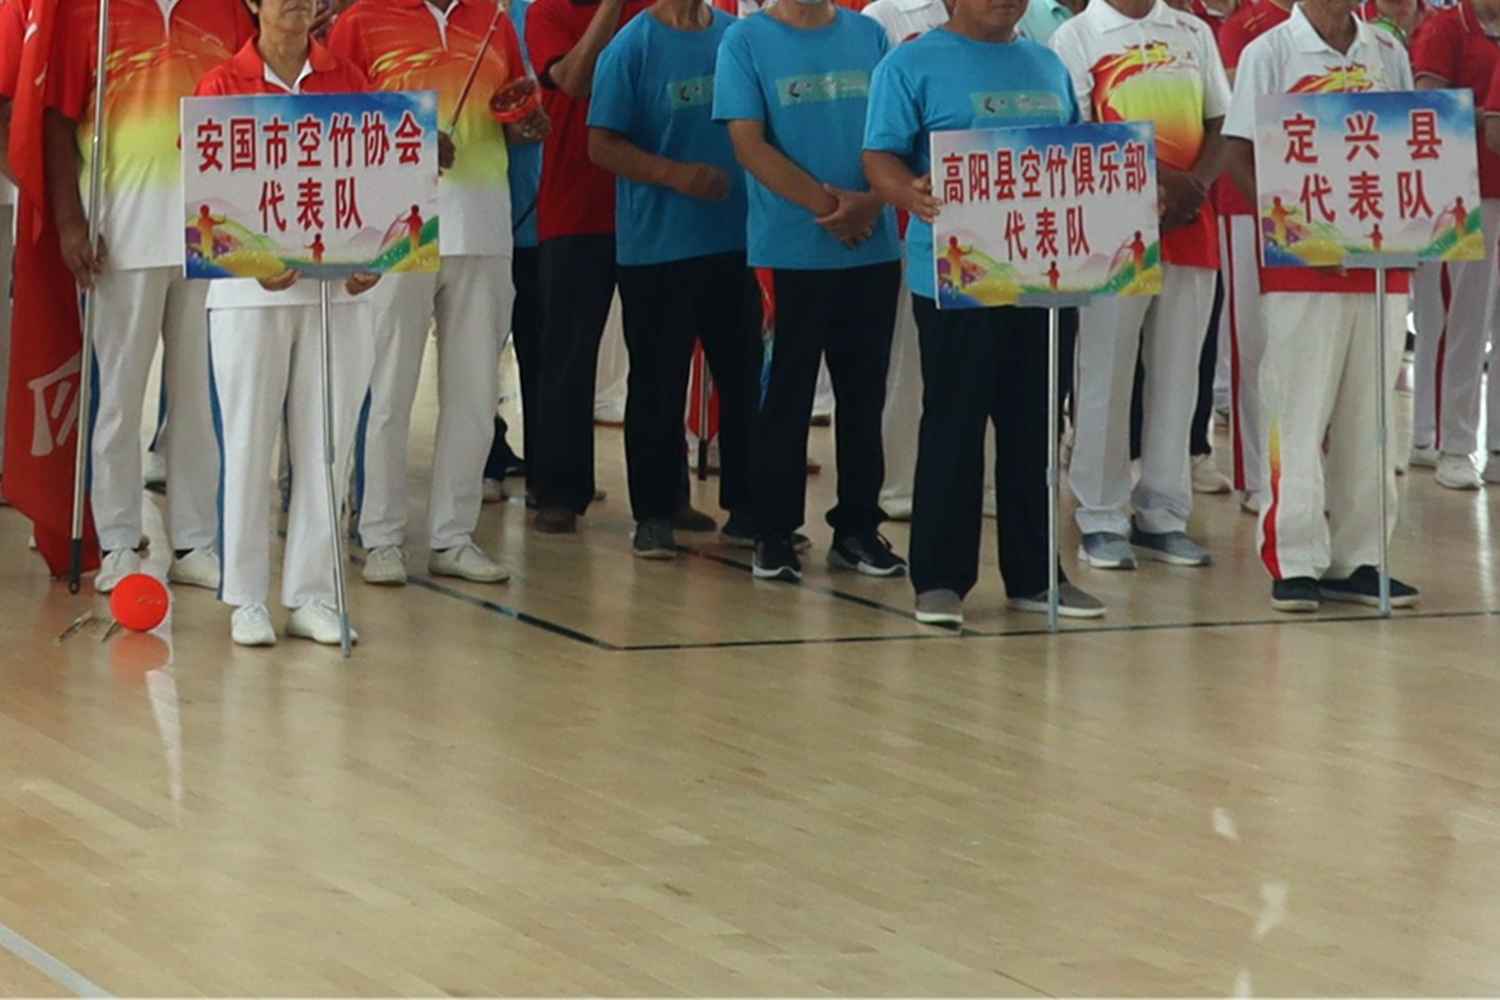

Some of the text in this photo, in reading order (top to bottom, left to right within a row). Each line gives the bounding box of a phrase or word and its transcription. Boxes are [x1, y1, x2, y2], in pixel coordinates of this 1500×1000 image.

[197, 112, 422, 174] 安国市空竹协会
[1283, 111, 1442, 164] 定兴县
[942, 142, 1147, 204] 高阳县空竹俱乐部
[1300, 170, 1434, 223] 代表队
[259, 178, 363, 233] 代表队
[1004, 206, 1091, 261] 代表队
